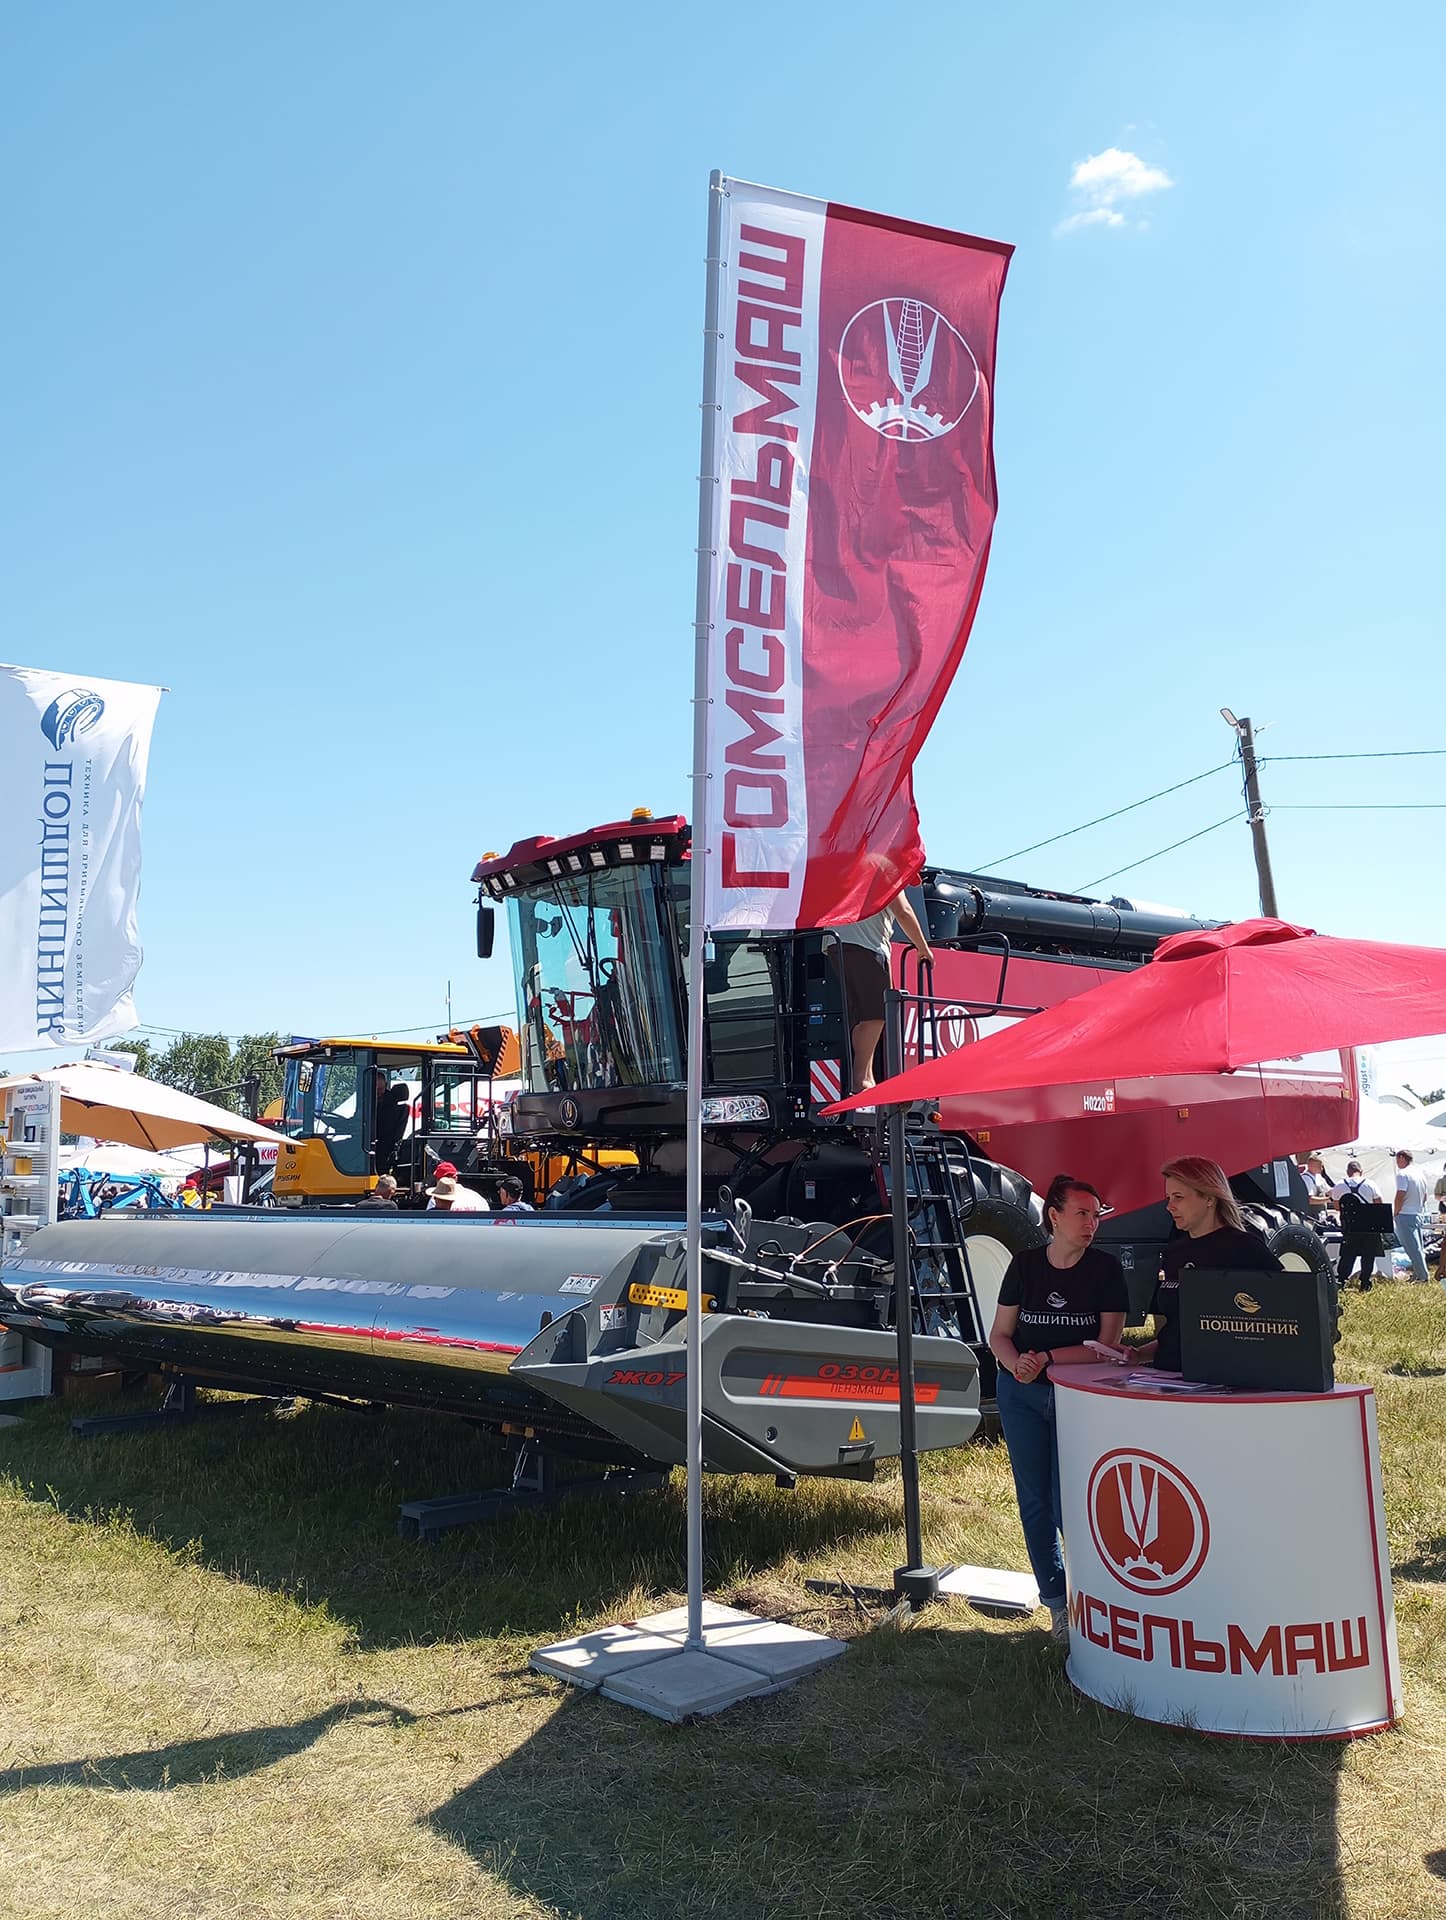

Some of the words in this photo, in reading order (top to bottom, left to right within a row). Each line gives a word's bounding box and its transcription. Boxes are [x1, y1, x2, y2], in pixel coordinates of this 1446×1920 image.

[720, 223, 806, 890] ГОМСЕЛЬМАШ
[82, 759, 92, 816] ТЕХНИКА
[36, 760, 73, 1037] ПОДШИПНИК
[1019, 1311, 1096, 1326] ПОДШИПНИК
[1200, 1319, 1299, 1336] ПОДШИПНИК
[831, 1383, 885, 1396] ПЕНЗМАШ
